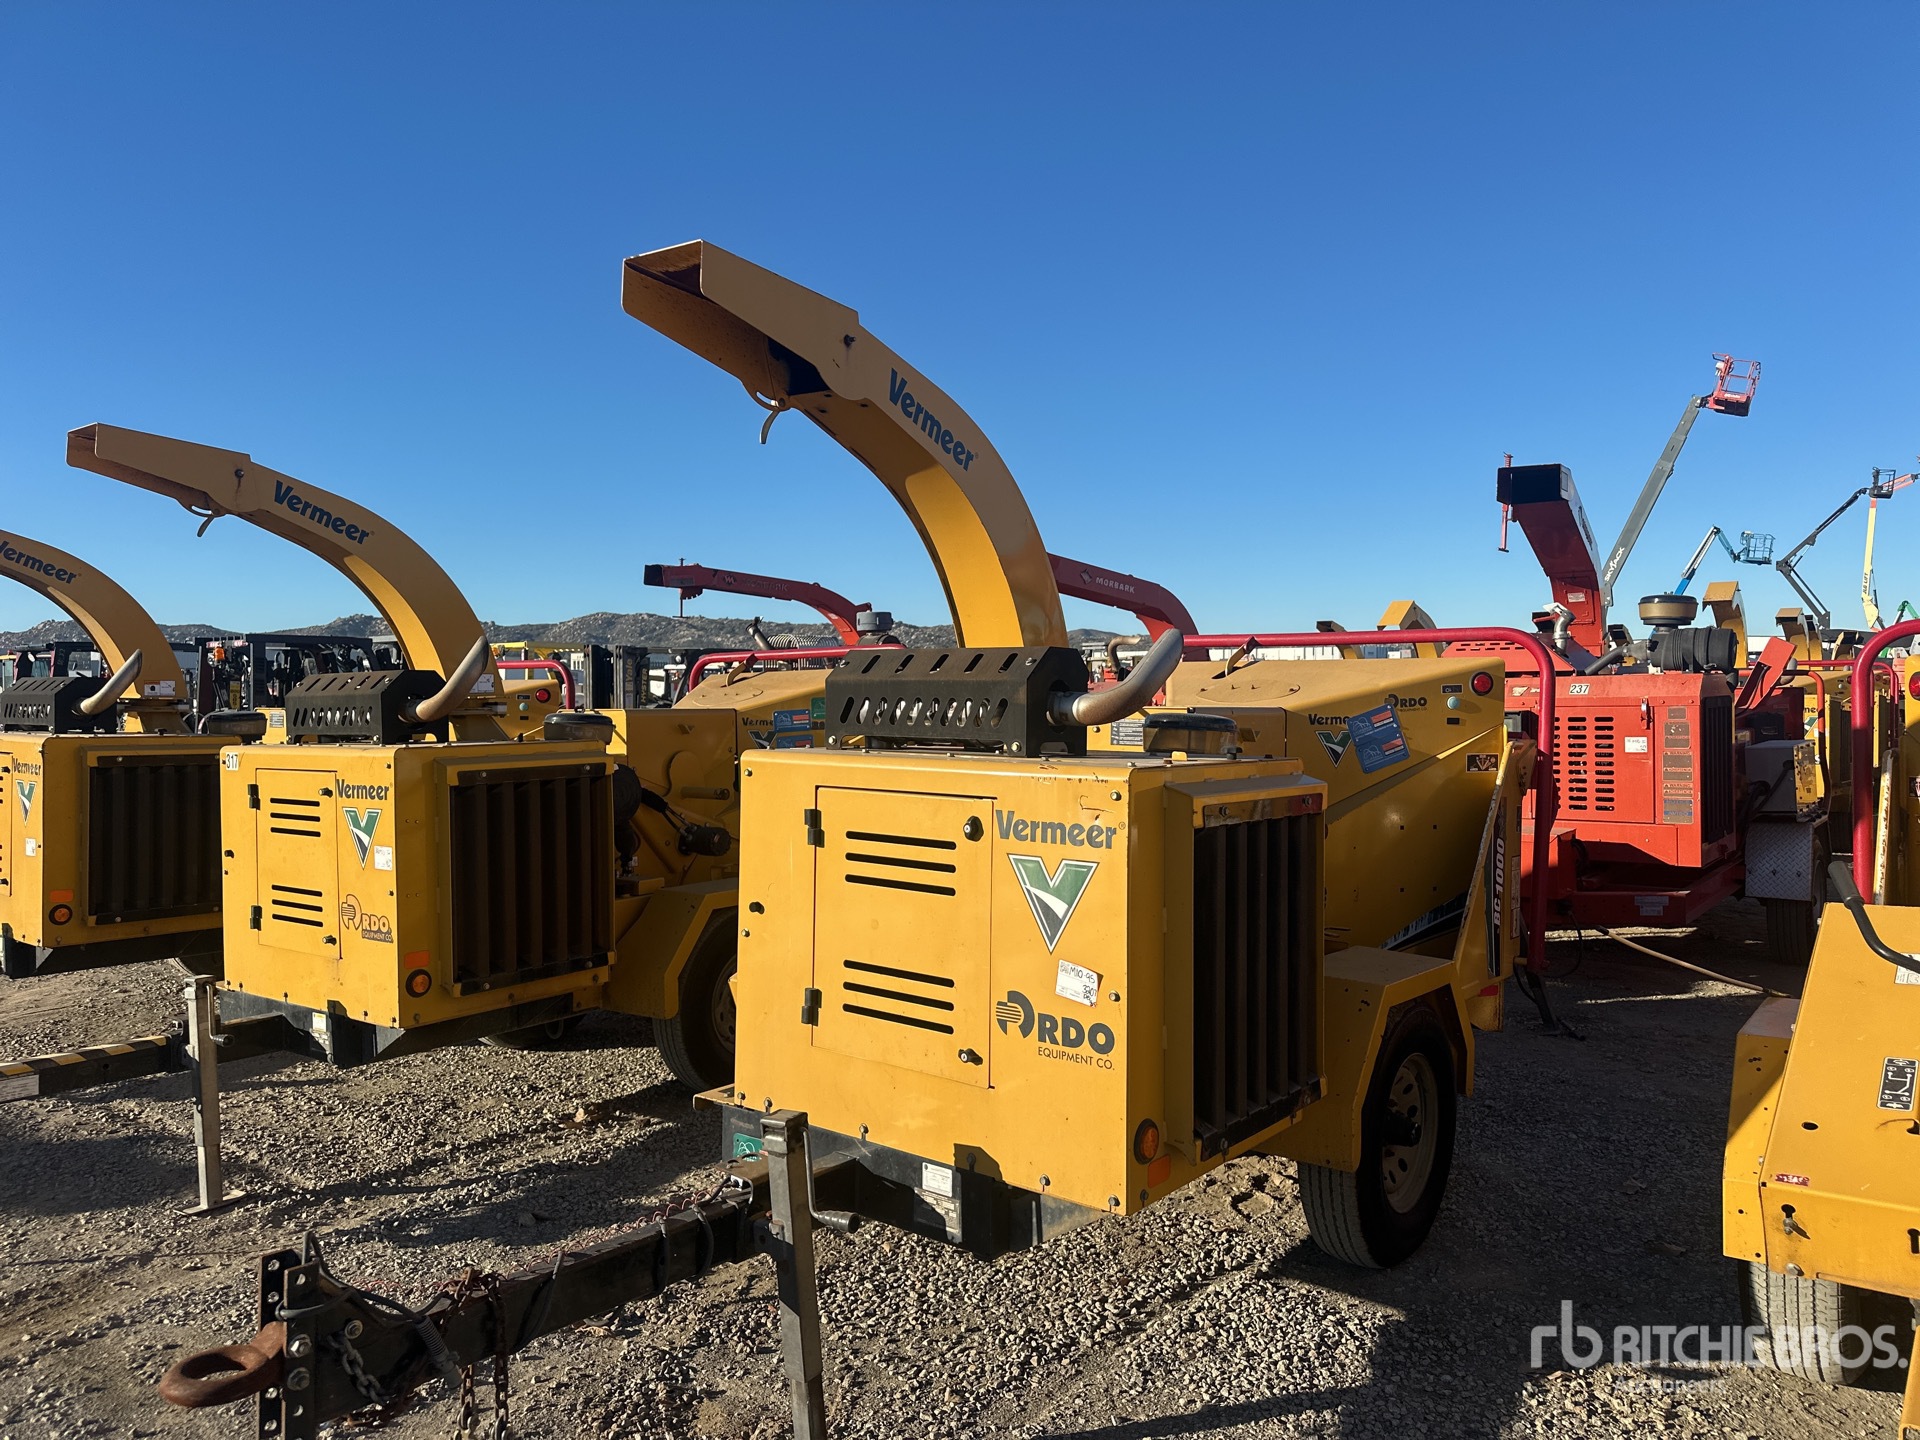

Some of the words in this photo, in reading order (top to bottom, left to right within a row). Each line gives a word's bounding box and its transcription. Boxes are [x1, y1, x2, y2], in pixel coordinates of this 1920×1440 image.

[889, 367, 975, 472] Vermeer
[274, 480, 370, 545] Vermeer
[1095, 576, 1135, 594] MORBARK
[1570, 684, 1589, 694] 237
[226, 753, 239, 769] 317
[336, 779, 390, 801] Vermeer
[995, 809, 1117, 850] Vermeer
[1495, 837, 1505, 893] 1000
[1493, 897, 1501, 926] BC
[1037, 1046, 1094, 1066] EQUIPMENT
[1096, 1057, 1116, 1071] CO.
